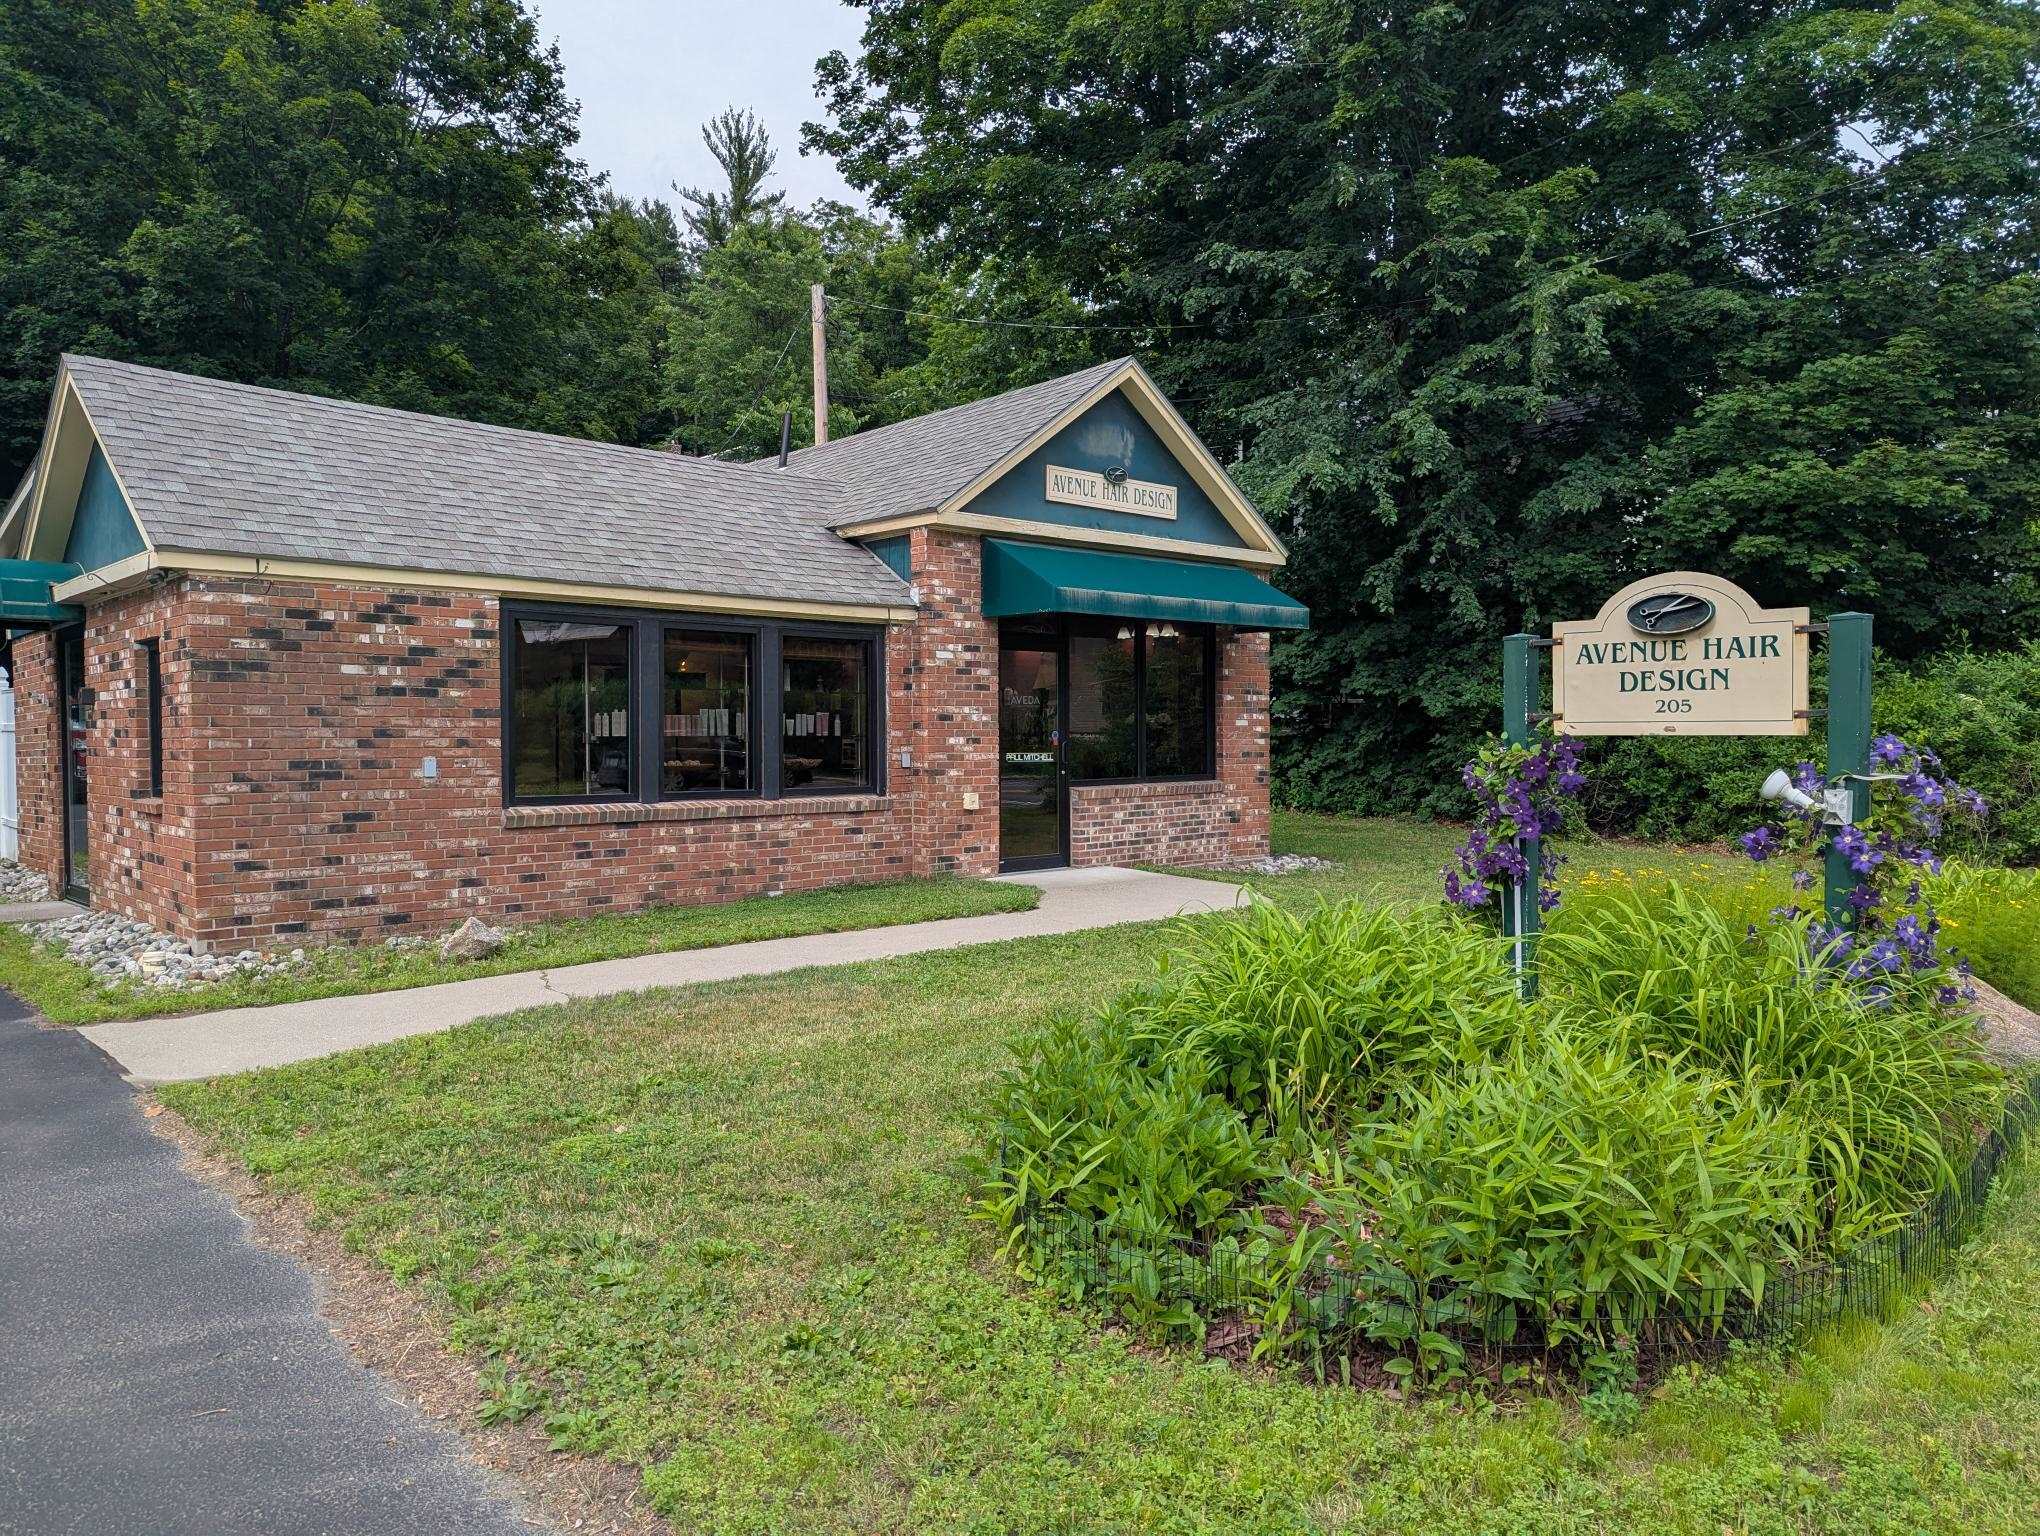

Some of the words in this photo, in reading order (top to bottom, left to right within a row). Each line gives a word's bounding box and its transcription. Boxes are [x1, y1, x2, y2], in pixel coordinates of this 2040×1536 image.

[1052, 474, 1097, 498] AVENUE
[1102, 483, 1129, 503] HAIR
[1133, 488, 1173, 511] DESIGN
[1575, 639, 1689, 665] AVENUE
[1703, 635, 1782, 660] HAIR
[1618, 667, 1730, 693] DESIGN
[1010, 695, 1041, 705] AVEDA
[1654, 699, 1693, 714] 205
[1006, 752, 1023, 761] PAUL
[1023, 752, 1054, 761] MITCHELL
